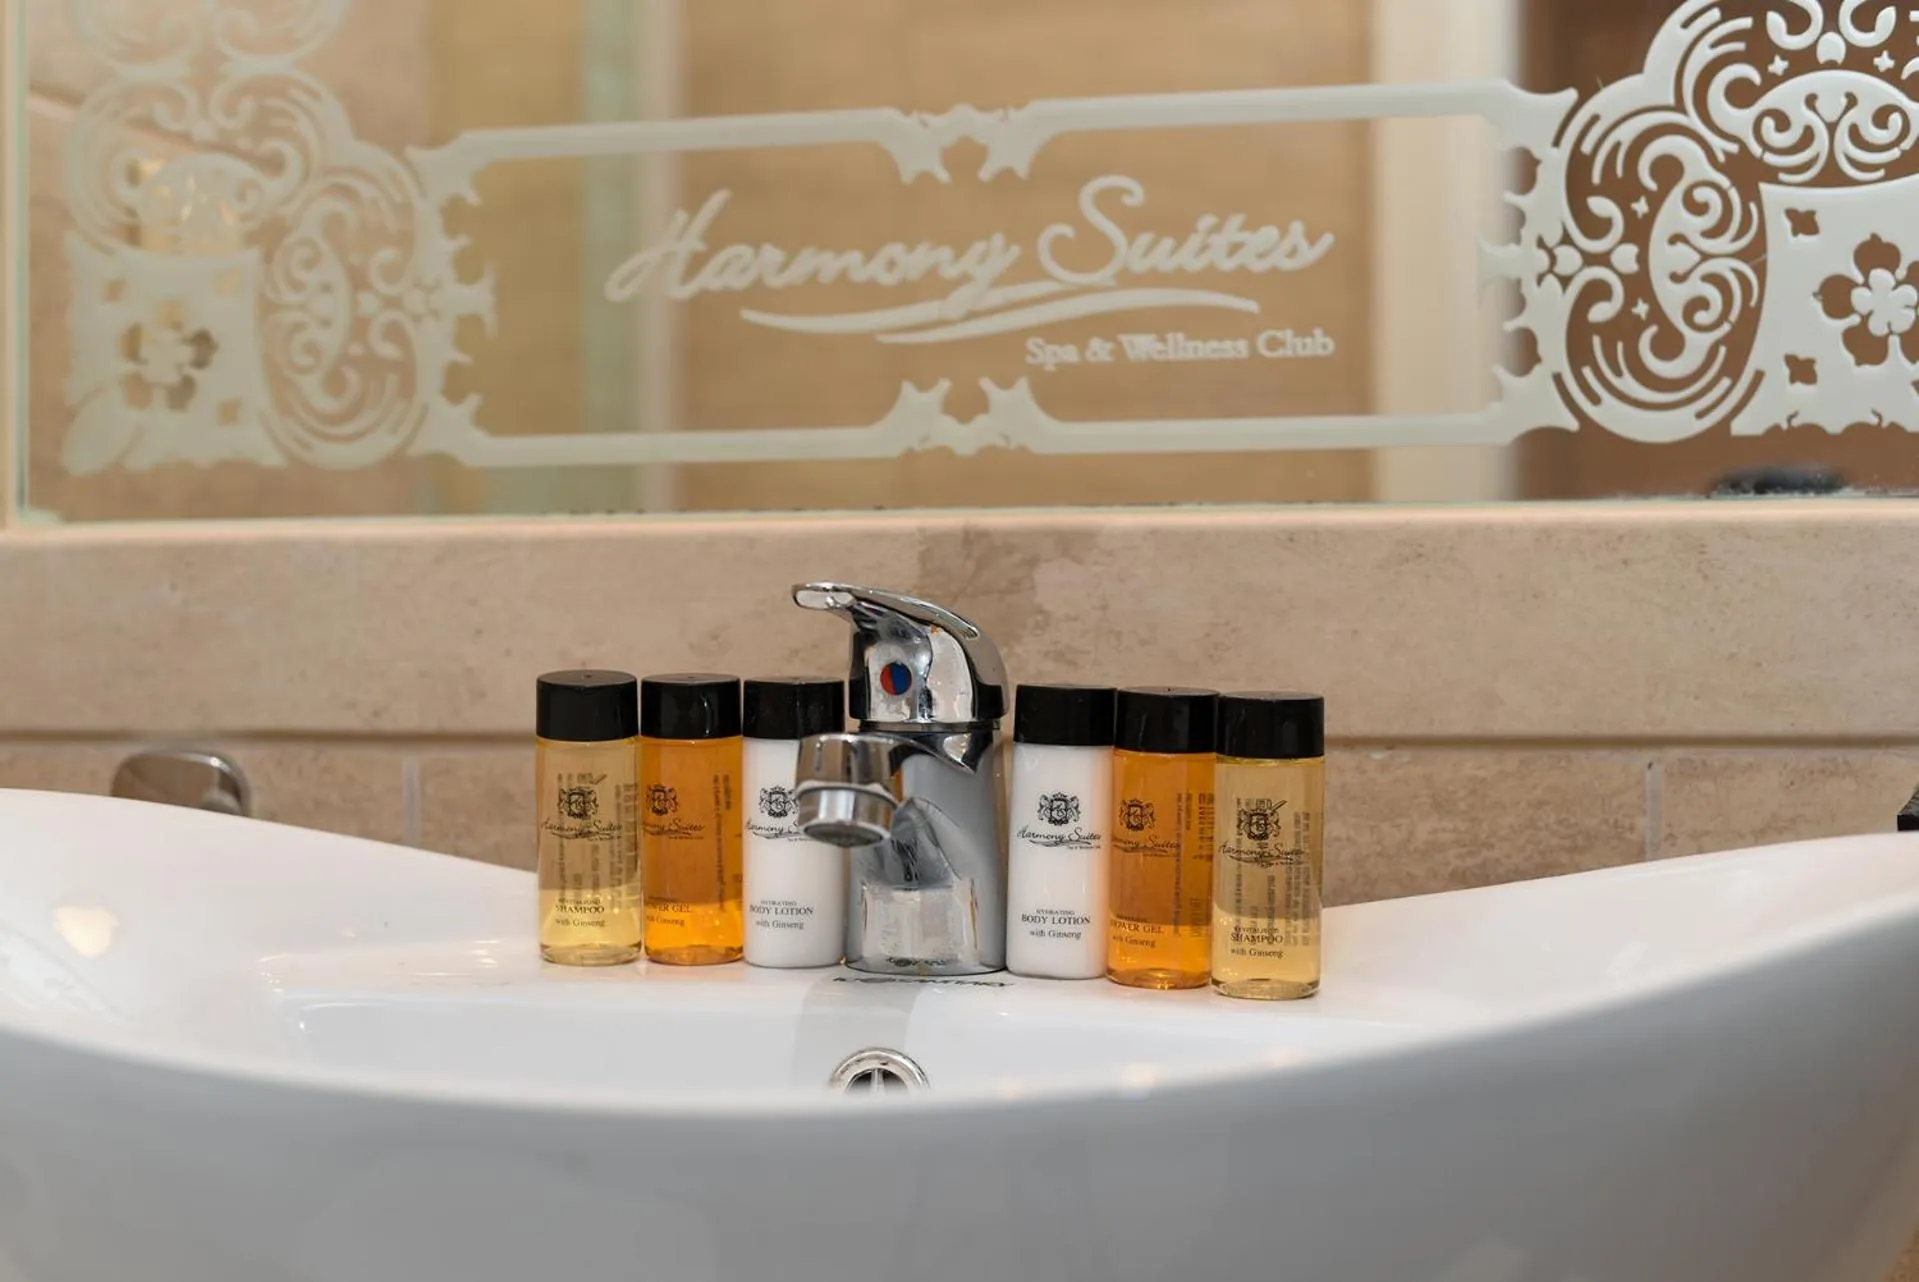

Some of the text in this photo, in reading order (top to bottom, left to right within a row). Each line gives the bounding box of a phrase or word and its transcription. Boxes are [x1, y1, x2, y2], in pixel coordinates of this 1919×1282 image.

[605, 174, 1334, 320] Harmony Suites
[1024, 327, 1335, 371] Spa & Wellness Club
[1017, 825, 1102, 842] Harmony Suites
[555, 904, 605, 914] SHAMPOO
[671, 903, 692, 914] GEL
[750, 904, 814, 916] BODY LOTION
[573, 919, 605, 928] Ginseng
[756, 919, 804, 930] with Ginseng
[1021, 914, 1091, 925] BODY LOTION
[1029, 928, 1082, 940] with Ginseng
[1143, 923, 1164, 934] GEL
[1125, 936, 1156, 948] Ginseng
[1230, 932, 1284, 945] SHAMPOO
[1231, 947, 1284, 960] with Ginseng
